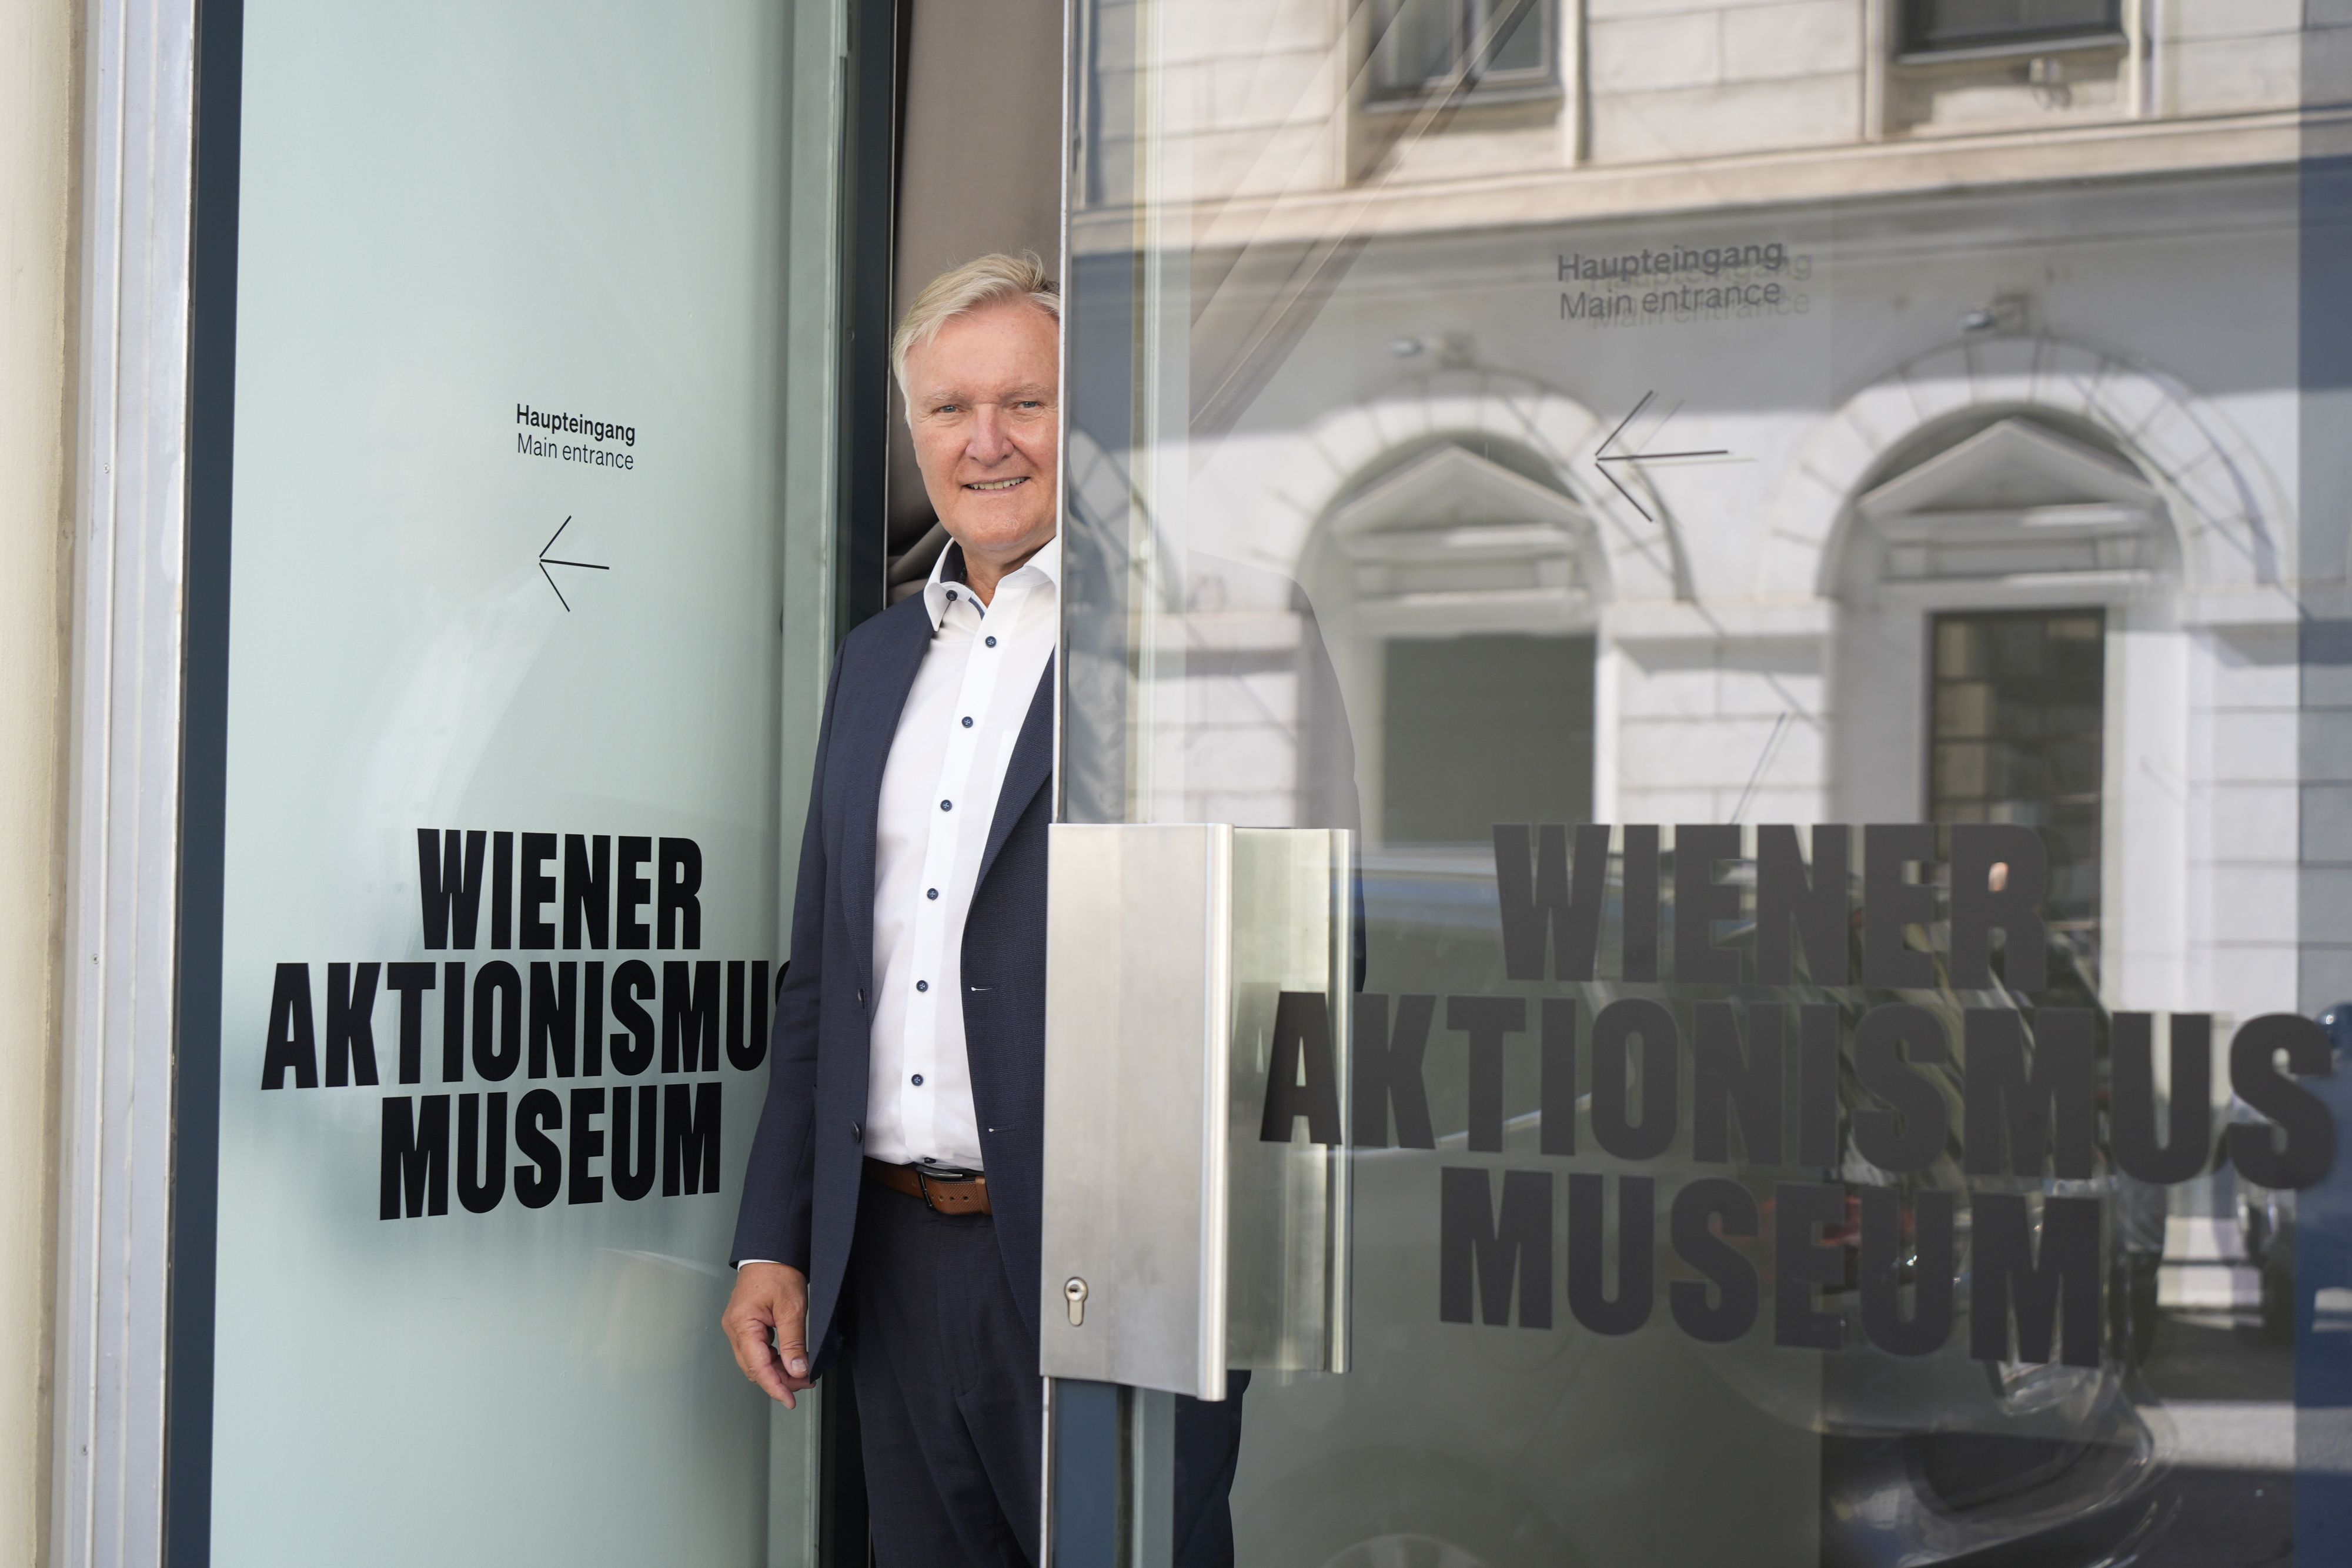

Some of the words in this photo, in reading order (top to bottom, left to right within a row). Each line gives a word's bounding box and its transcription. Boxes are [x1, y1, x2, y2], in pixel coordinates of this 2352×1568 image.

[1557, 242, 1783, 282] Haupteingang
[1560, 289, 1632, 320] Main
[1642, 282, 1781, 314] entrance
[517, 403, 635, 447] Haupteingang
[518, 433, 557, 459] Main
[562, 444, 634, 470] entrance
[417, 828, 702, 950] WIENER
[1491, 823, 2048, 991] WIENER
[261, 960, 790, 1090] AKTIONISMU
[380, 1082, 721, 1221] MUSEUM
[1259, 991, 2333, 1189] AKTIONISMUS
[1439, 1166, 2102, 1368] MUSEUM
